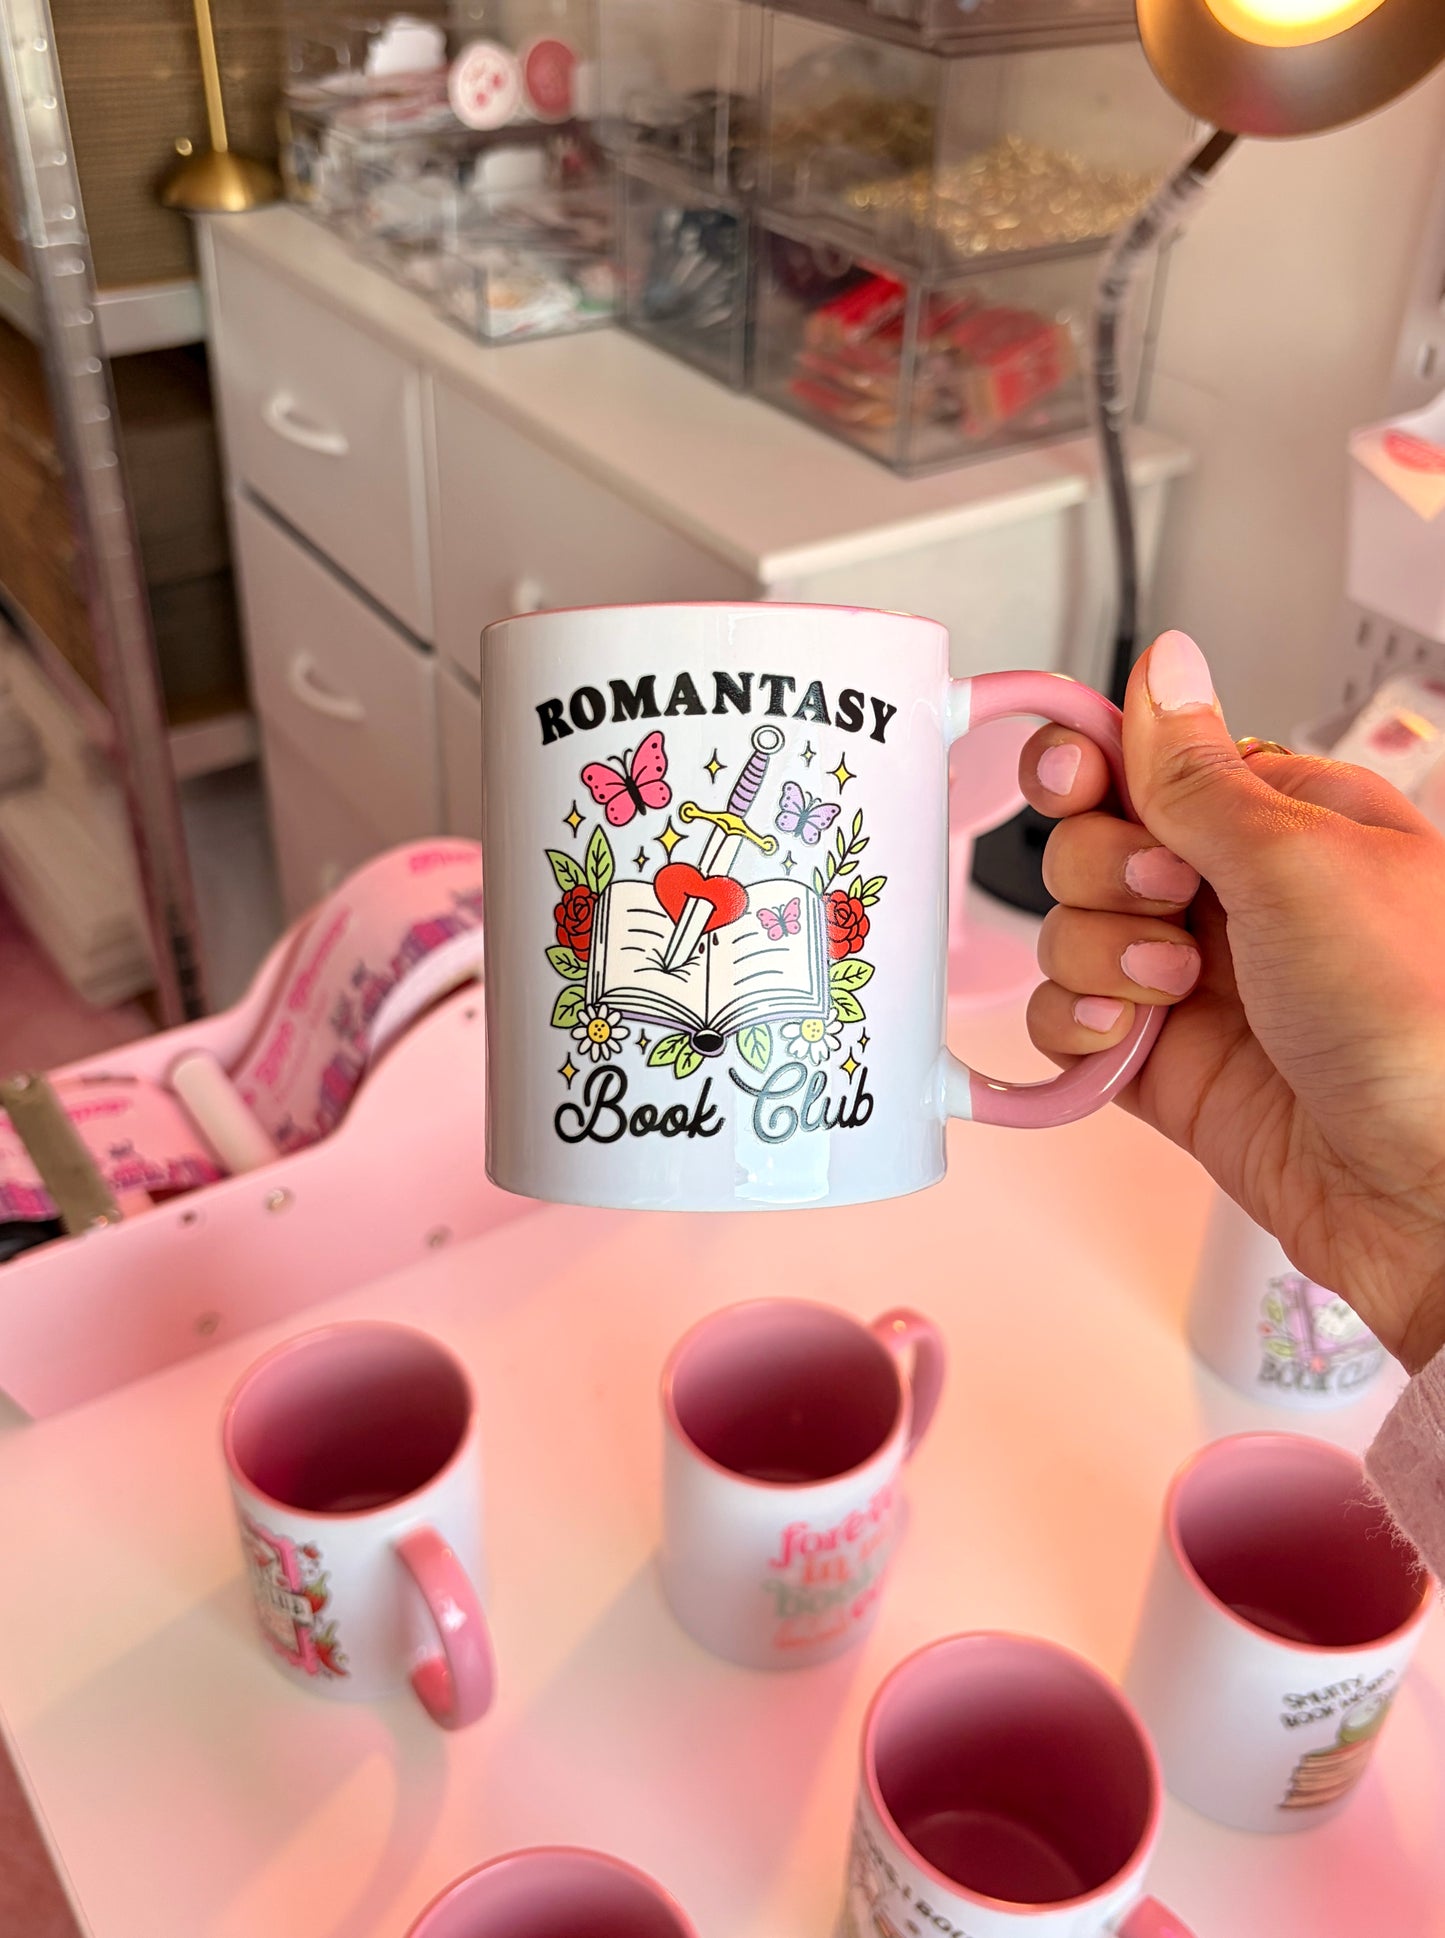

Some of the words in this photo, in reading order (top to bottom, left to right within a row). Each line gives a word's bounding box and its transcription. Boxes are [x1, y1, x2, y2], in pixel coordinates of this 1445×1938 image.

[535, 671, 898, 746] ROMANTASY
[554, 1063, 725, 1144] Book
[728, 1060, 874, 1144] Club
